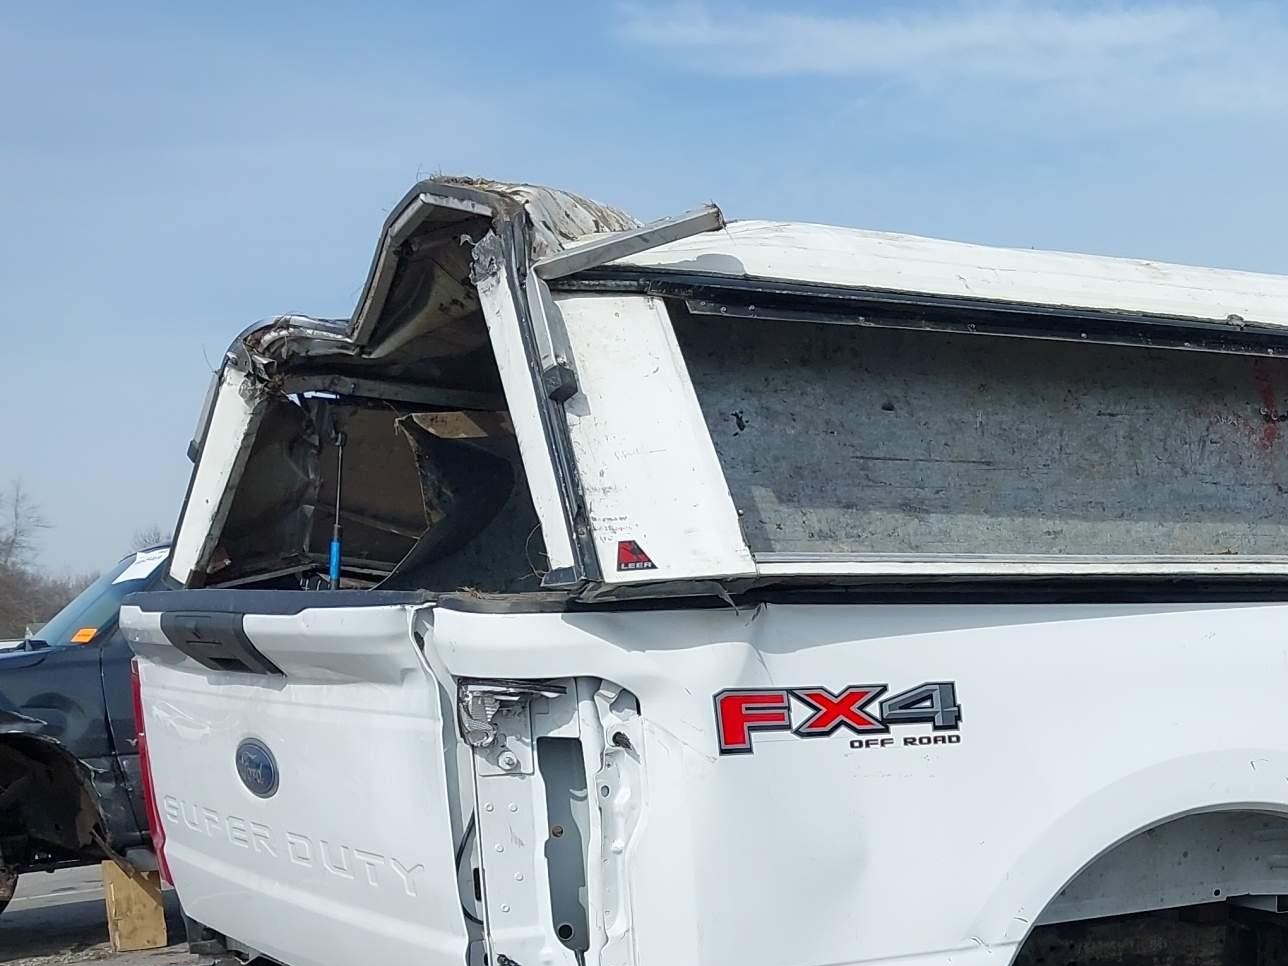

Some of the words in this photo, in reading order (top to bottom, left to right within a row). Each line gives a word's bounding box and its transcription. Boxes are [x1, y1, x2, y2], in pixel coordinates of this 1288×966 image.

[621, 562, 653, 570] LEER
[712, 681, 964, 756] FX4
[849, 738, 896, 750] OFF
[902, 734, 962, 747] ROAD
[163, 794, 279, 858] SUPER
[285, 830, 425, 897] DUTY
